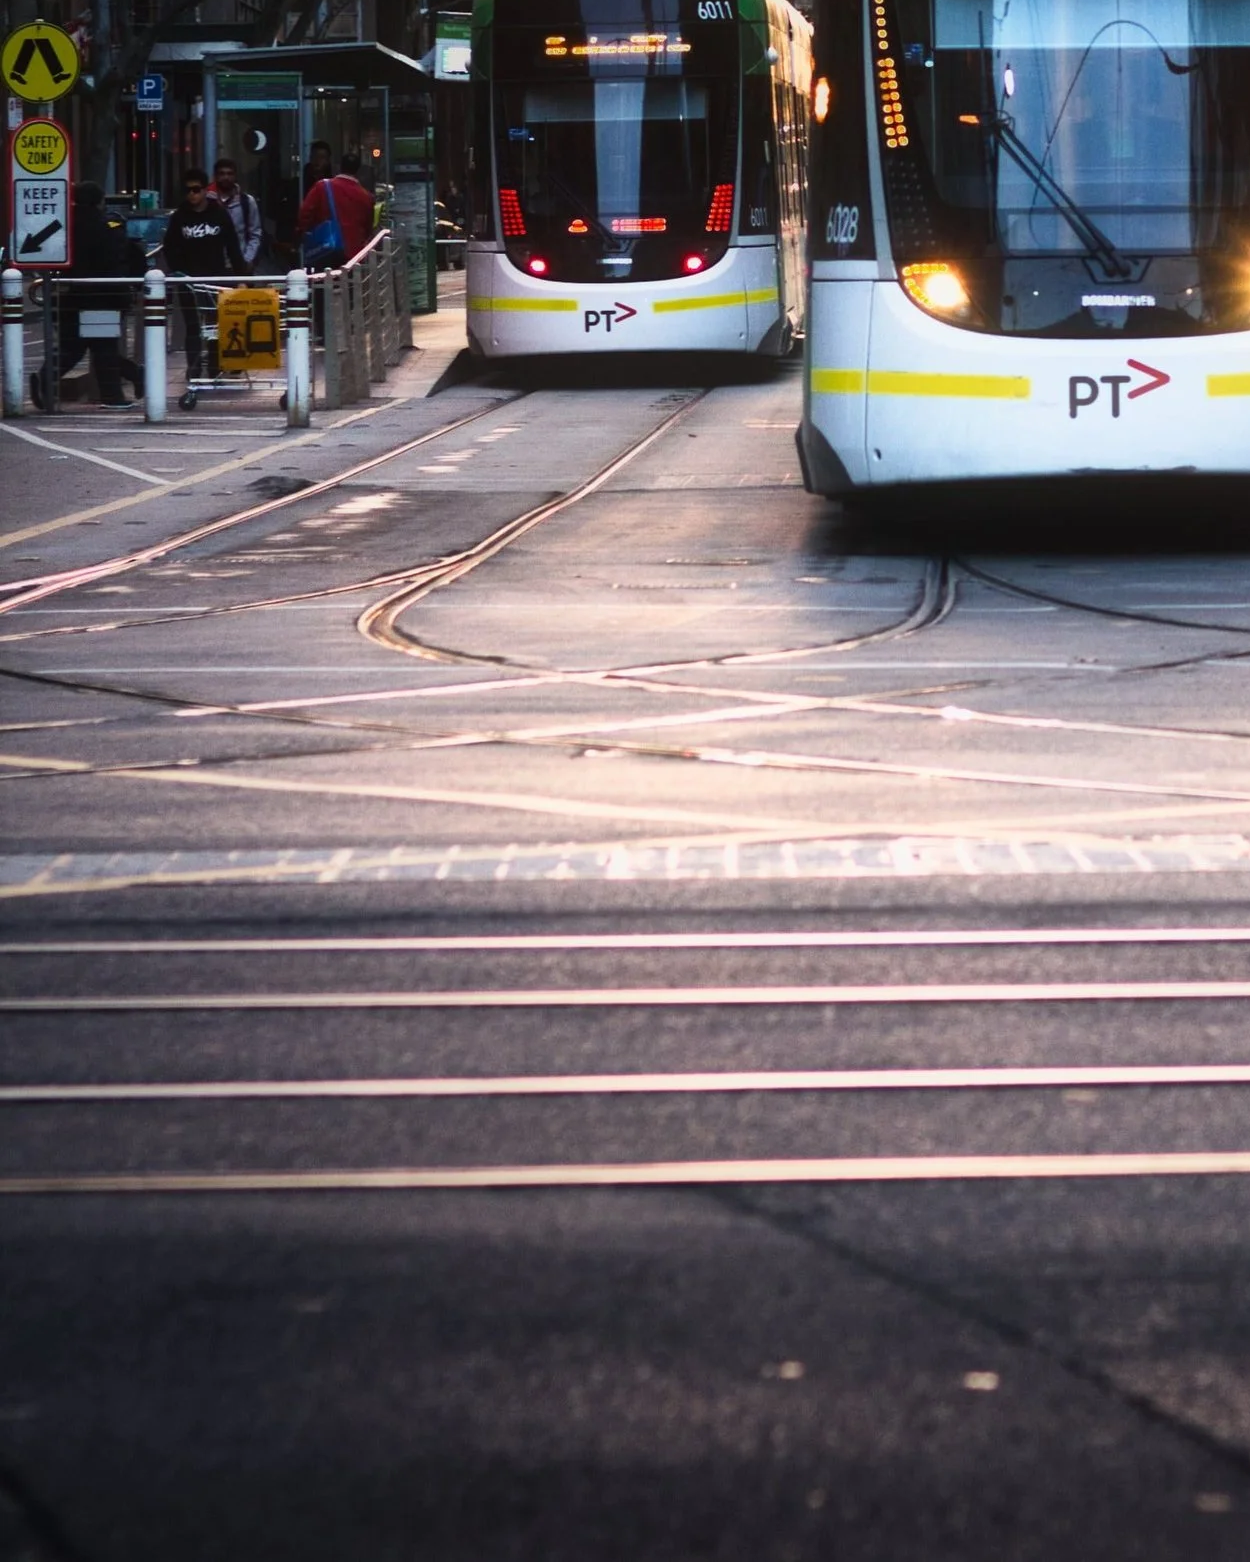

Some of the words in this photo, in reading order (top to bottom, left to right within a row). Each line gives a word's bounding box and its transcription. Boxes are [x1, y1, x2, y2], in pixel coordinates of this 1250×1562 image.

[697, 0, 734, 19] 6011
[143, 79, 156, 95] P
[21, 136, 59, 149] SAFETY
[27, 152, 54, 165] ZONE
[23, 188, 58, 200] KEEP
[24, 204, 58, 215] LEFT
[825, 204, 859, 244] 6028
